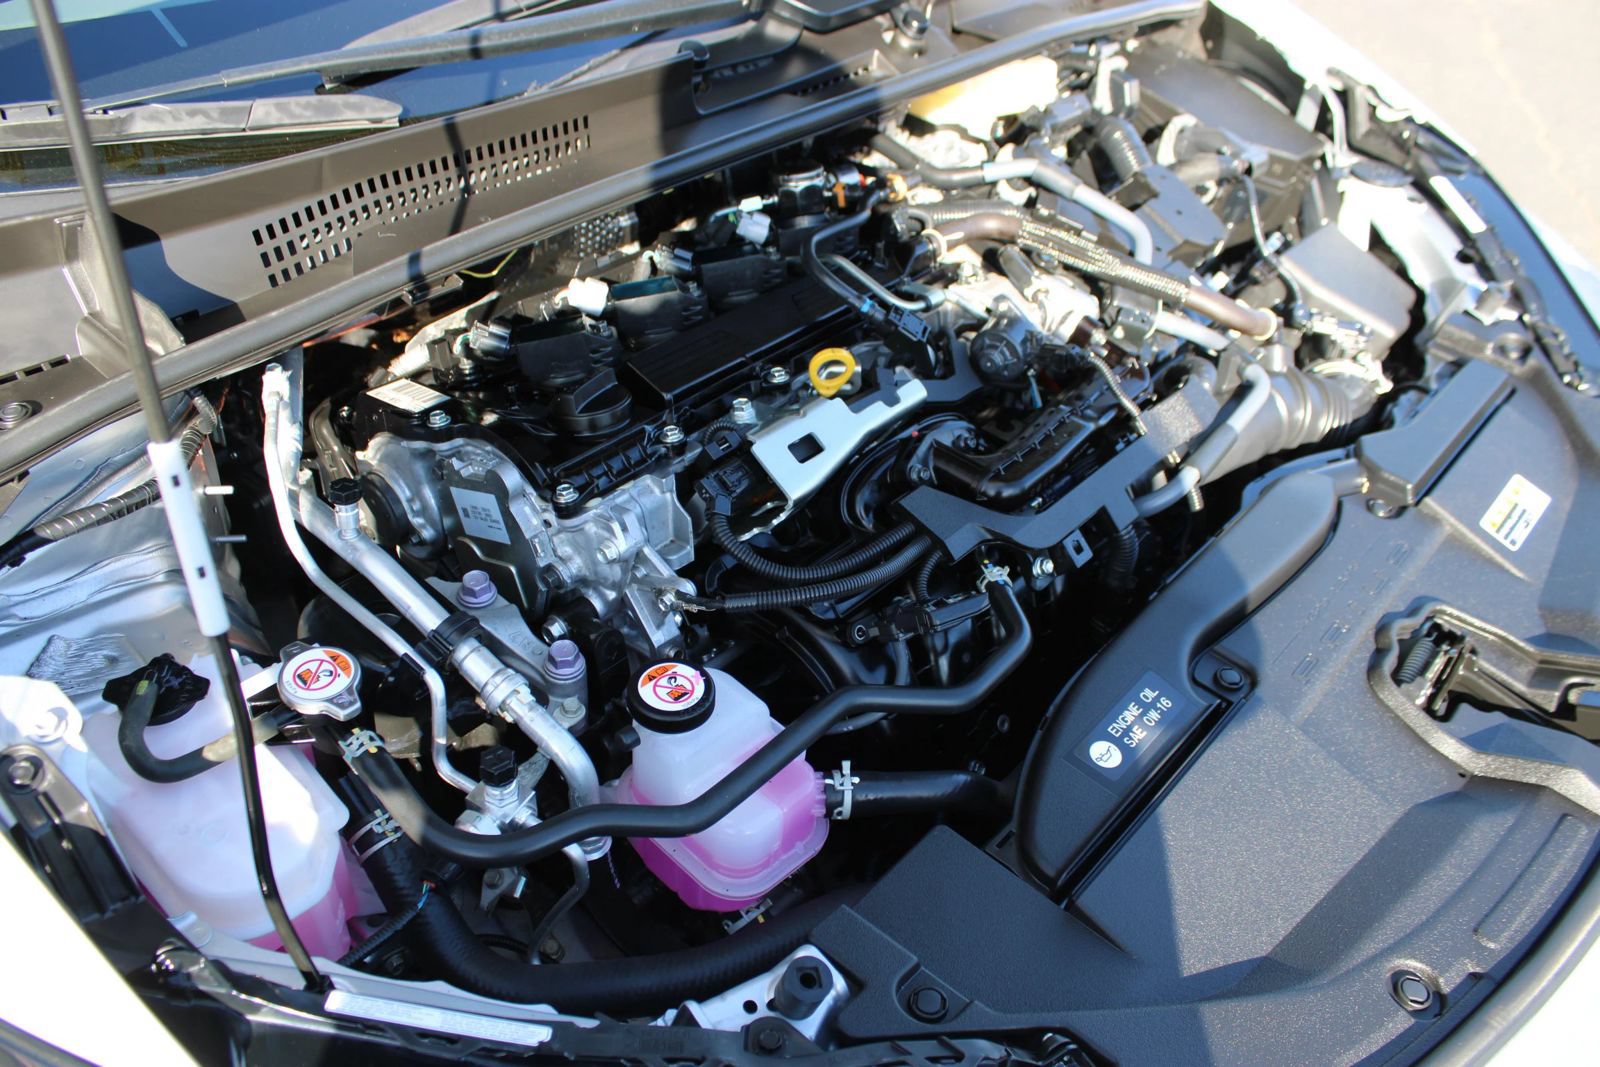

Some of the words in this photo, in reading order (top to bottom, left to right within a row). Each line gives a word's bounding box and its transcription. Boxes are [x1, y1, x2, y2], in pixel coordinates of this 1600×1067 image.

[1107, 701, 1144, 738] ENGINE
[1139, 687, 1160, 703] OIL
[1123, 724, 1148, 748] SAE
[1142, 697, 1173, 727] 0W-16
